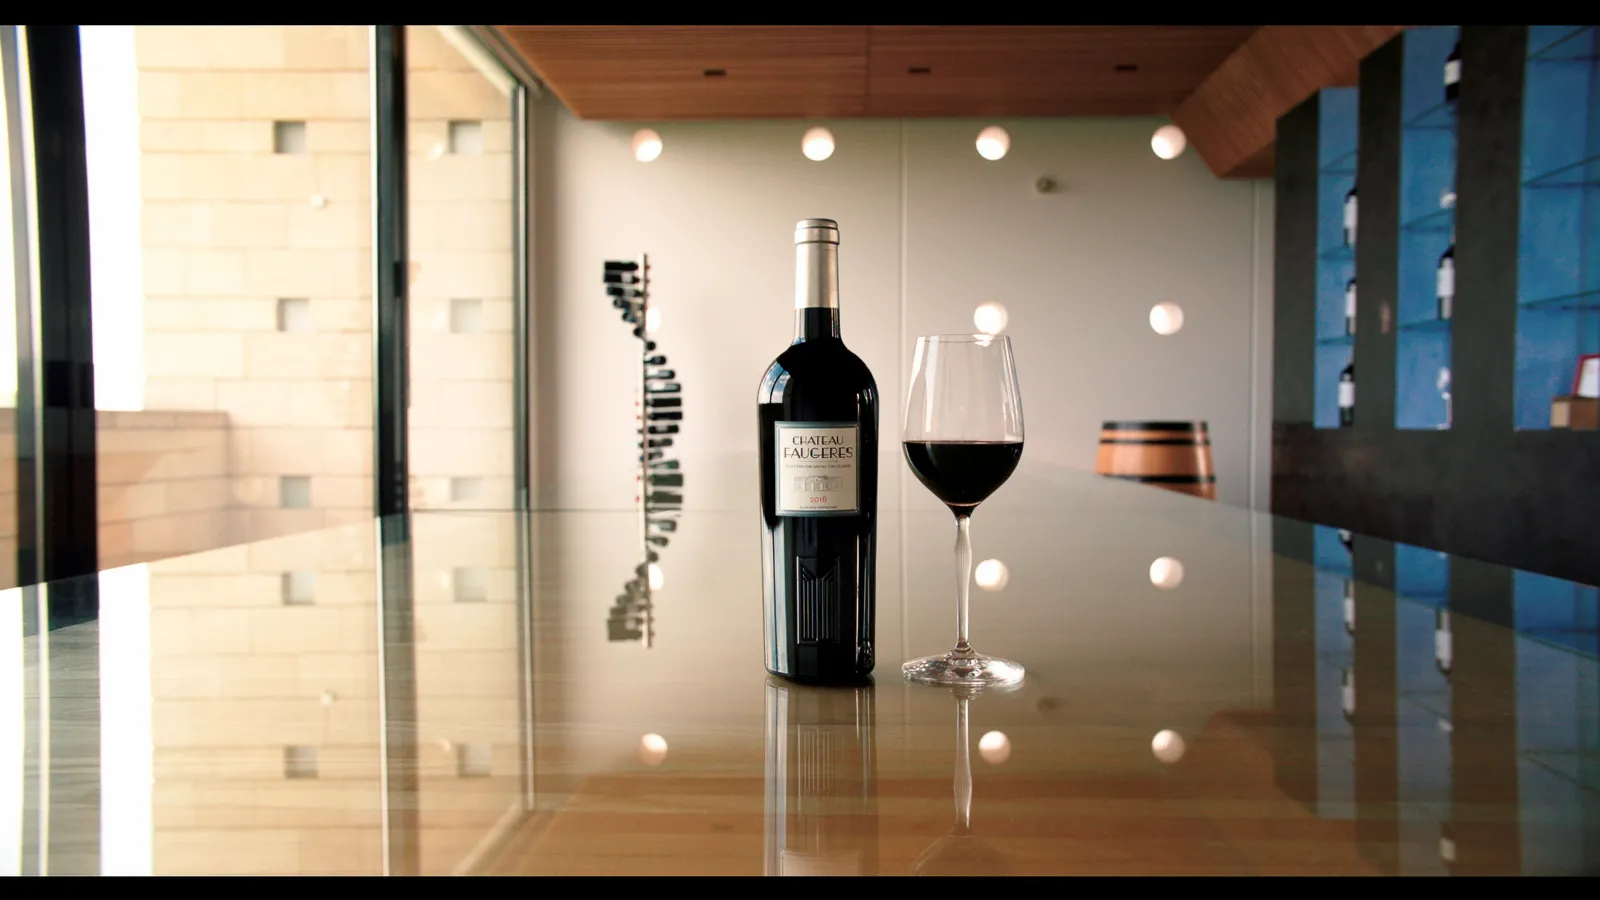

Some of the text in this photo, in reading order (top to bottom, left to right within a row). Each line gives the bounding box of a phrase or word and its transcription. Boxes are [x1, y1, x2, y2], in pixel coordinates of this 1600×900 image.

[792, 435, 844, 446] CHATEAU
[784, 446, 854, 459] FAUGERES
[809, 495, 828, 503] 2016
